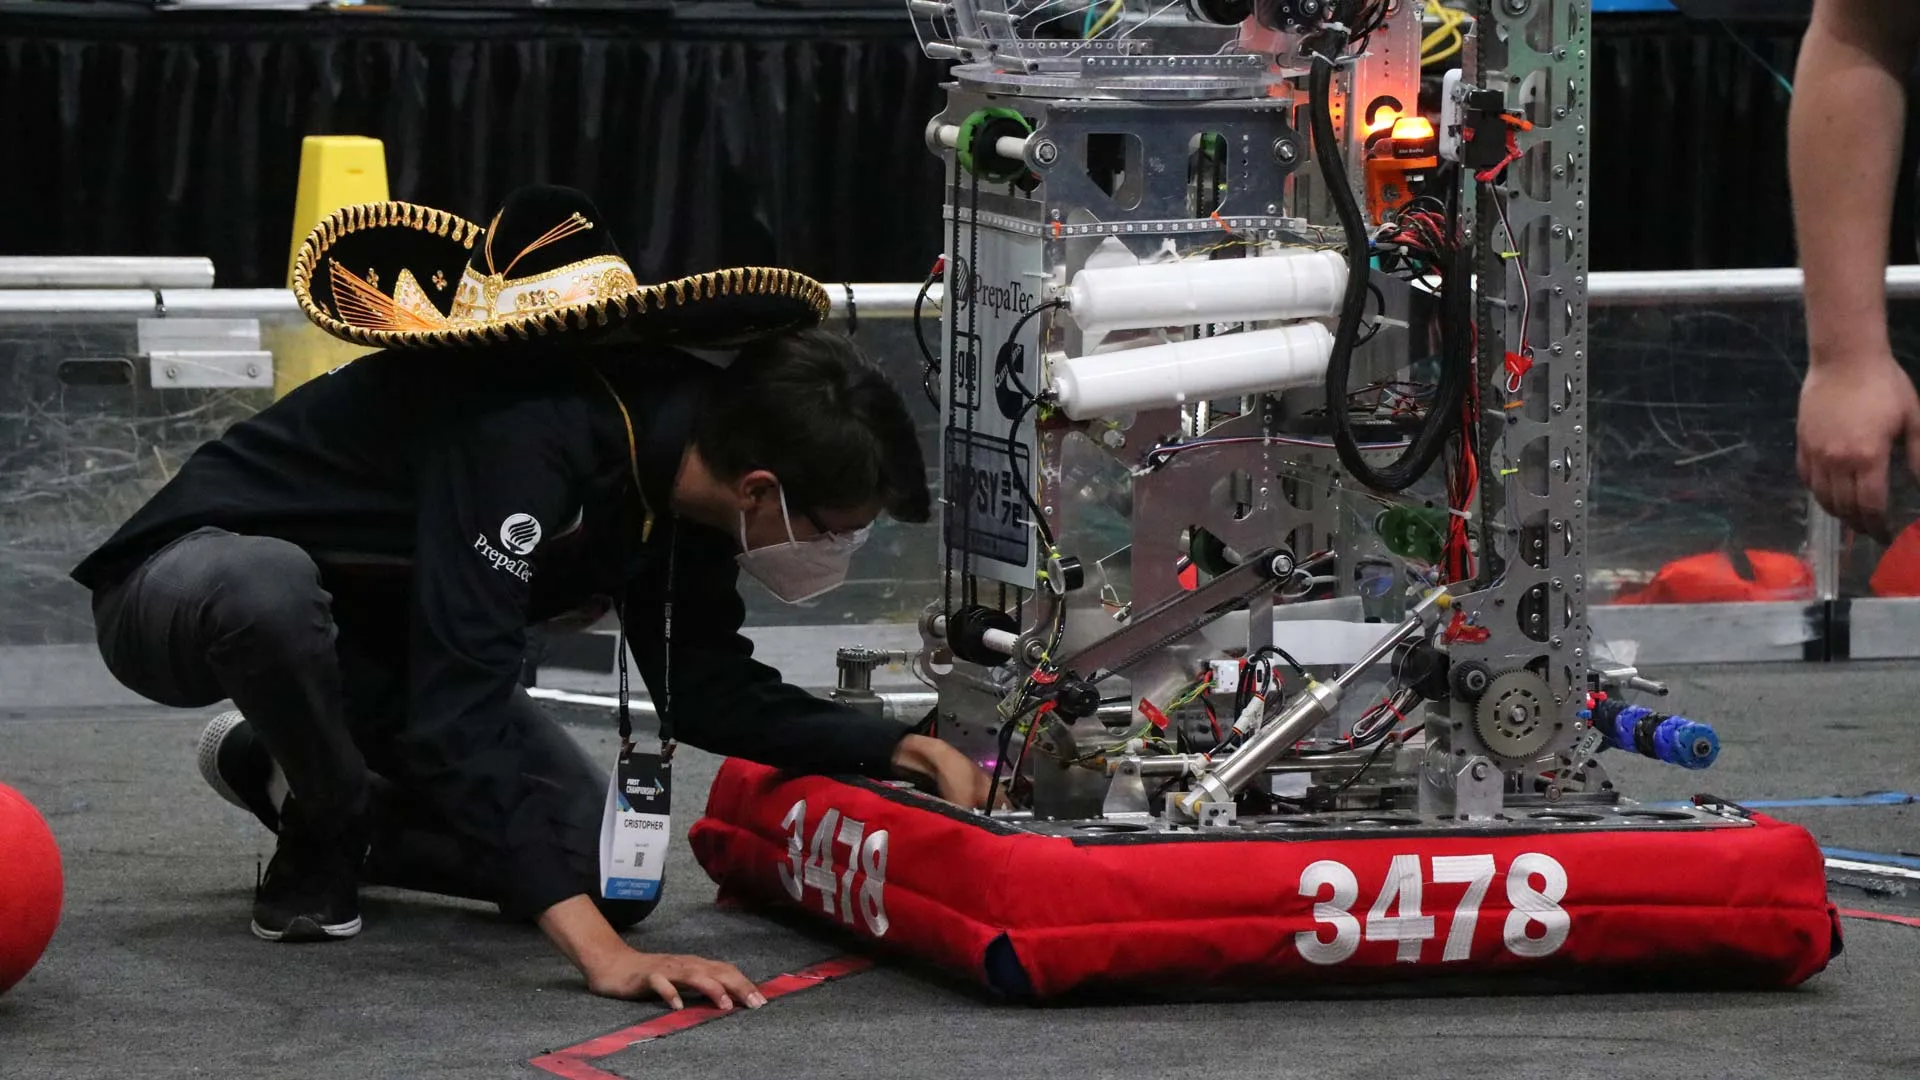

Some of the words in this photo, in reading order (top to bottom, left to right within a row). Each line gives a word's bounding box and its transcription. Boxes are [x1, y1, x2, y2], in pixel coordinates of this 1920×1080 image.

[973, 274, 1034, 318] PrepaTec
[474, 532, 533, 583] PrepaTec
[623, 818, 664, 831] CRISTOPHER
[777, 799, 890, 937] 3478
[1295, 852, 1571, 966] 3478
